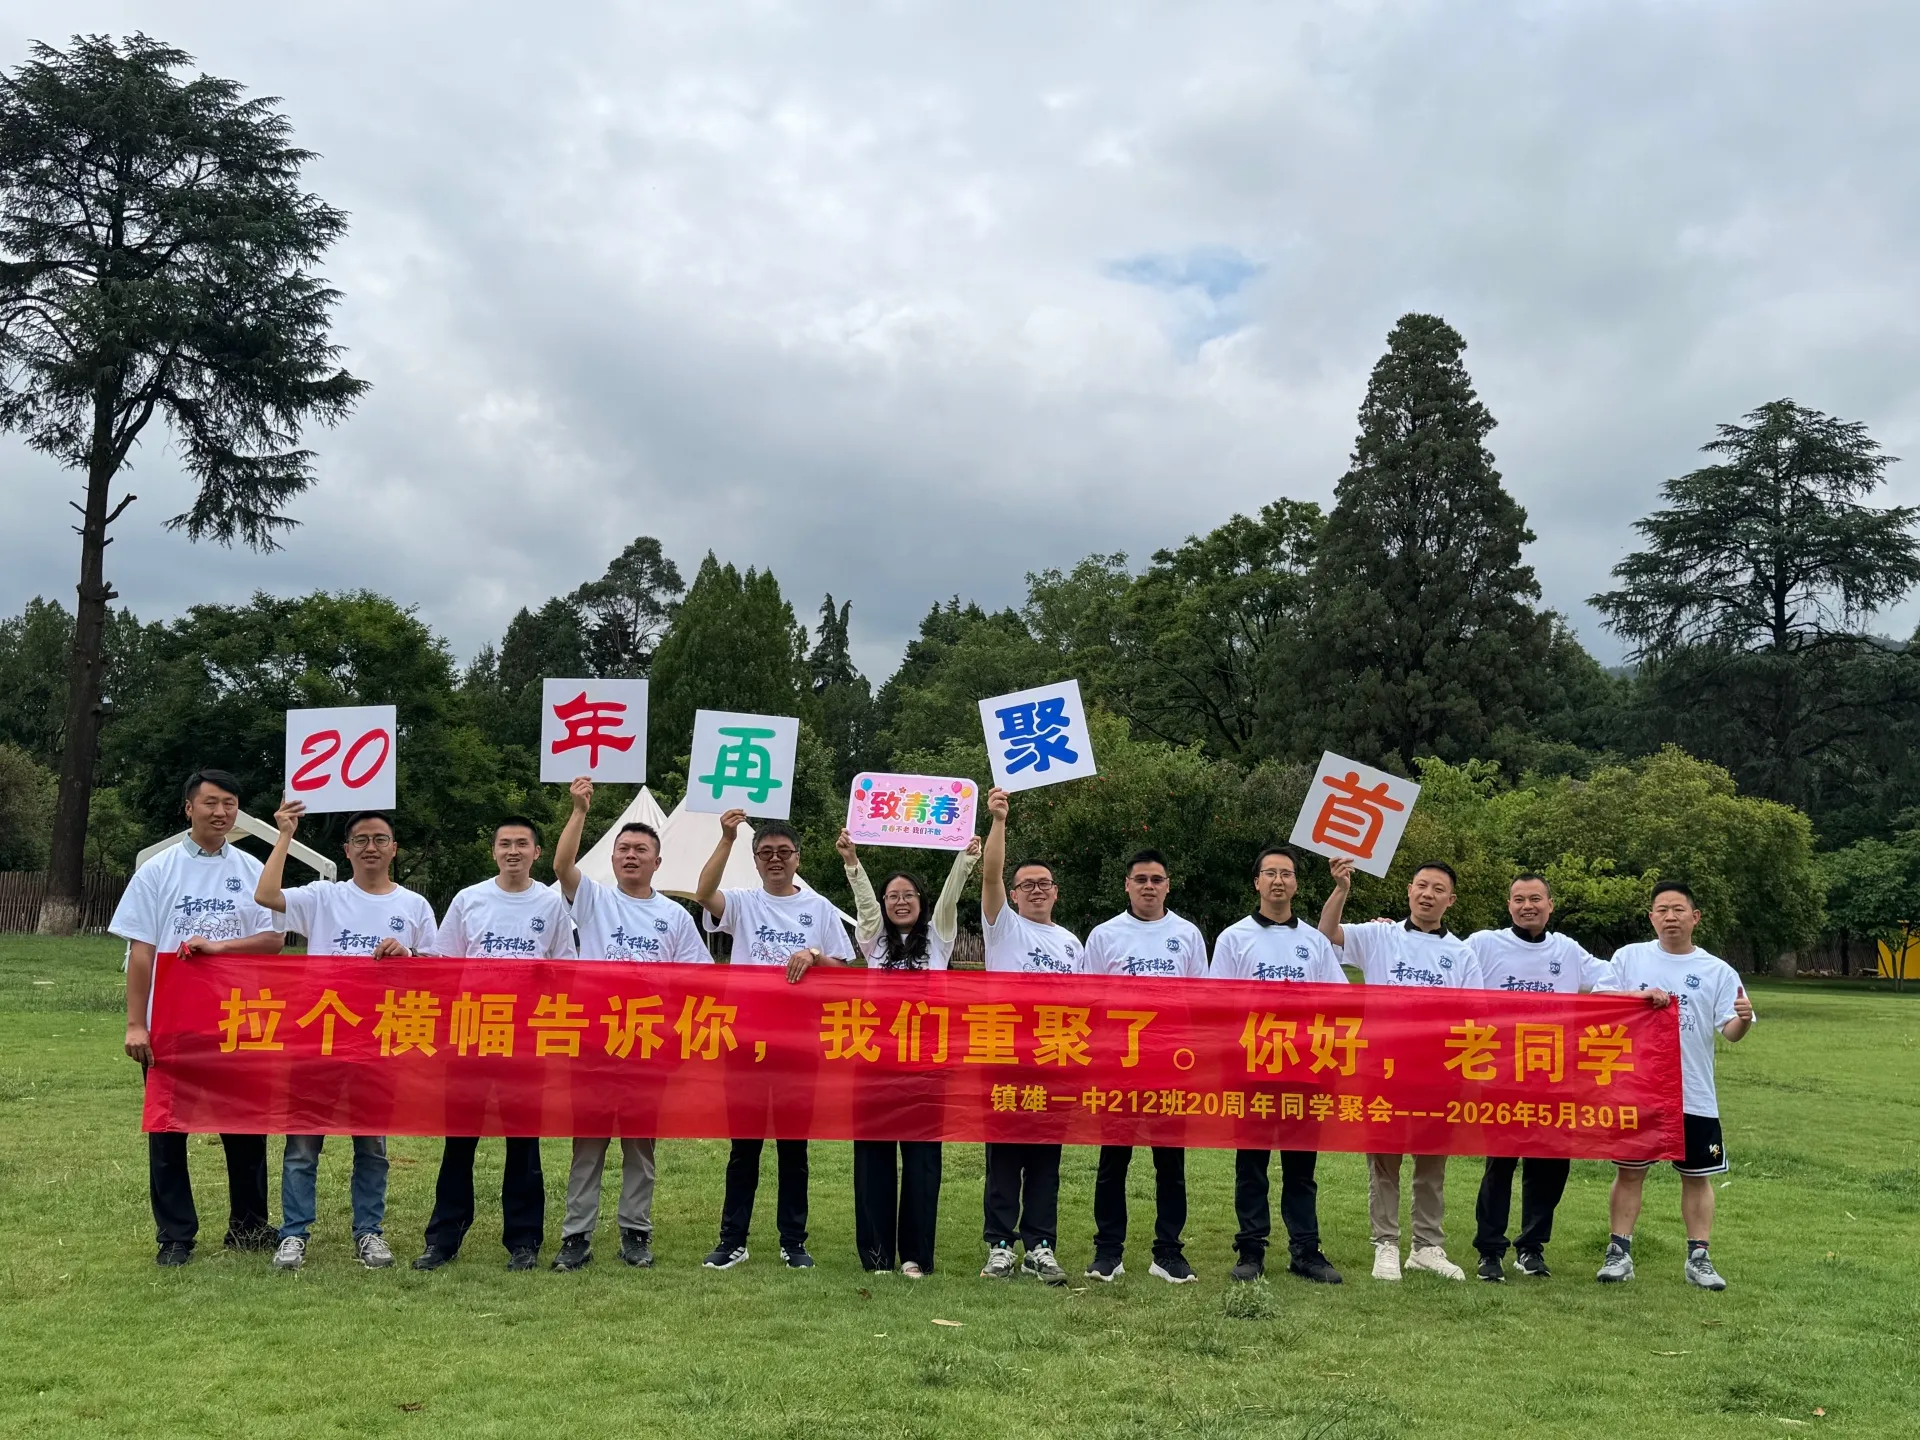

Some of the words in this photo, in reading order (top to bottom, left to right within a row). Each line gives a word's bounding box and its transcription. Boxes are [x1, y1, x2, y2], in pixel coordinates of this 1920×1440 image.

[291, 729, 390, 792] 20
[552, 691, 636, 769] 年
[698, 727, 783, 804] 再
[994, 697, 1079, 775] 聚
[867, 791, 960, 825] 致青春
[1311, 771, 1405, 860] 首
